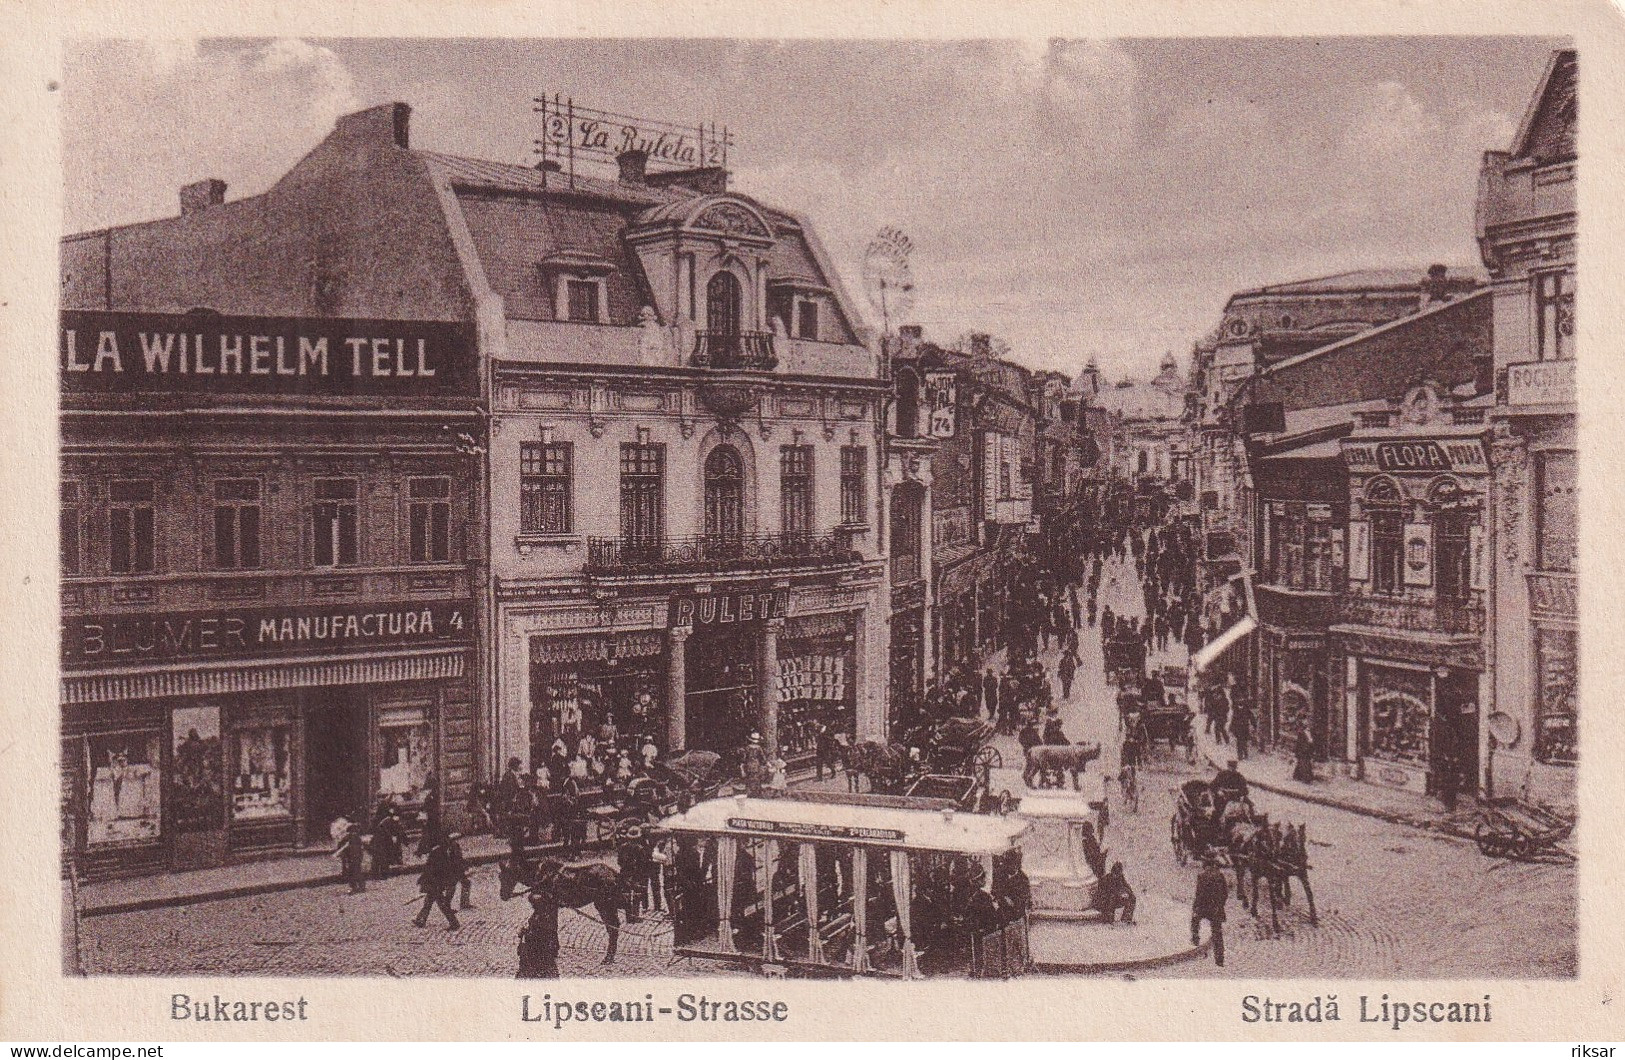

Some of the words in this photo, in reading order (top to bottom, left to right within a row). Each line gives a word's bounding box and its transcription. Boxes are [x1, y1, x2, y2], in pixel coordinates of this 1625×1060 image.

[552, 118, 565, 138] 2
[579, 121, 610, 148] La
[709, 145, 719, 164] 2
[66, 329, 124, 373] LA
[138, 332, 329, 377] WILHELM
[345, 337, 436, 378] TELL
[1381, 445, 1443, 467] FLORA
[677, 592, 791, 627] RULETA
[84, 618, 246, 655] BLUMER
